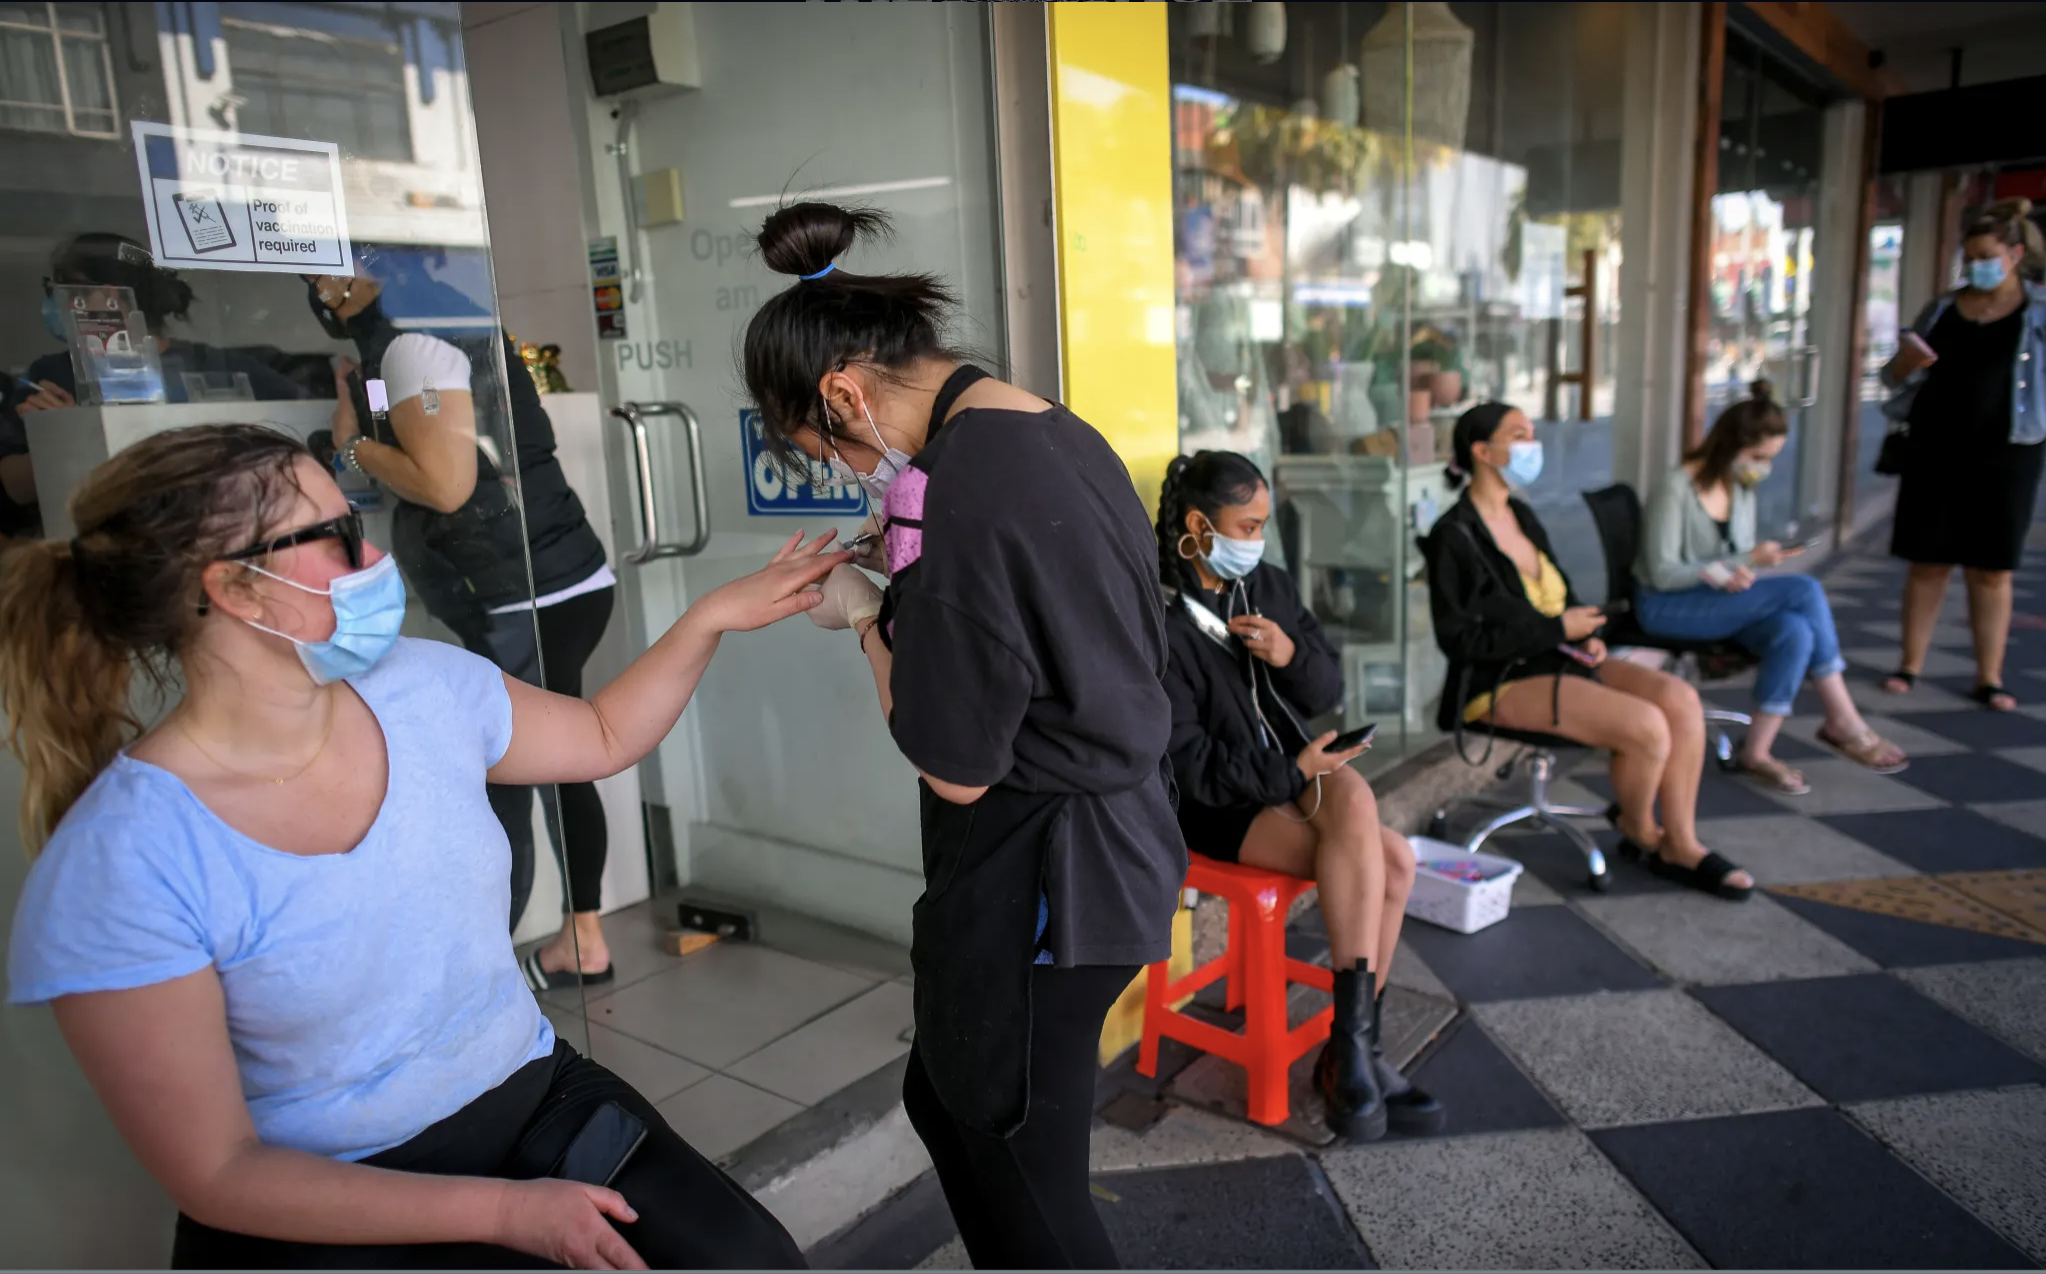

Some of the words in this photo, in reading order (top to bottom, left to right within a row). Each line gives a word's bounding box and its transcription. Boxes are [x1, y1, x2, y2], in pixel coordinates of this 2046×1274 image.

[187, 150, 298, 180] NOTICE
[253, 199, 291, 214] Proof
[294, 201, 309, 214] of
[256, 219, 334, 236] vaccination
[259, 239, 317, 255] required
[690, 228, 760, 267] Ope
[617, 339, 693, 372] PUSH
